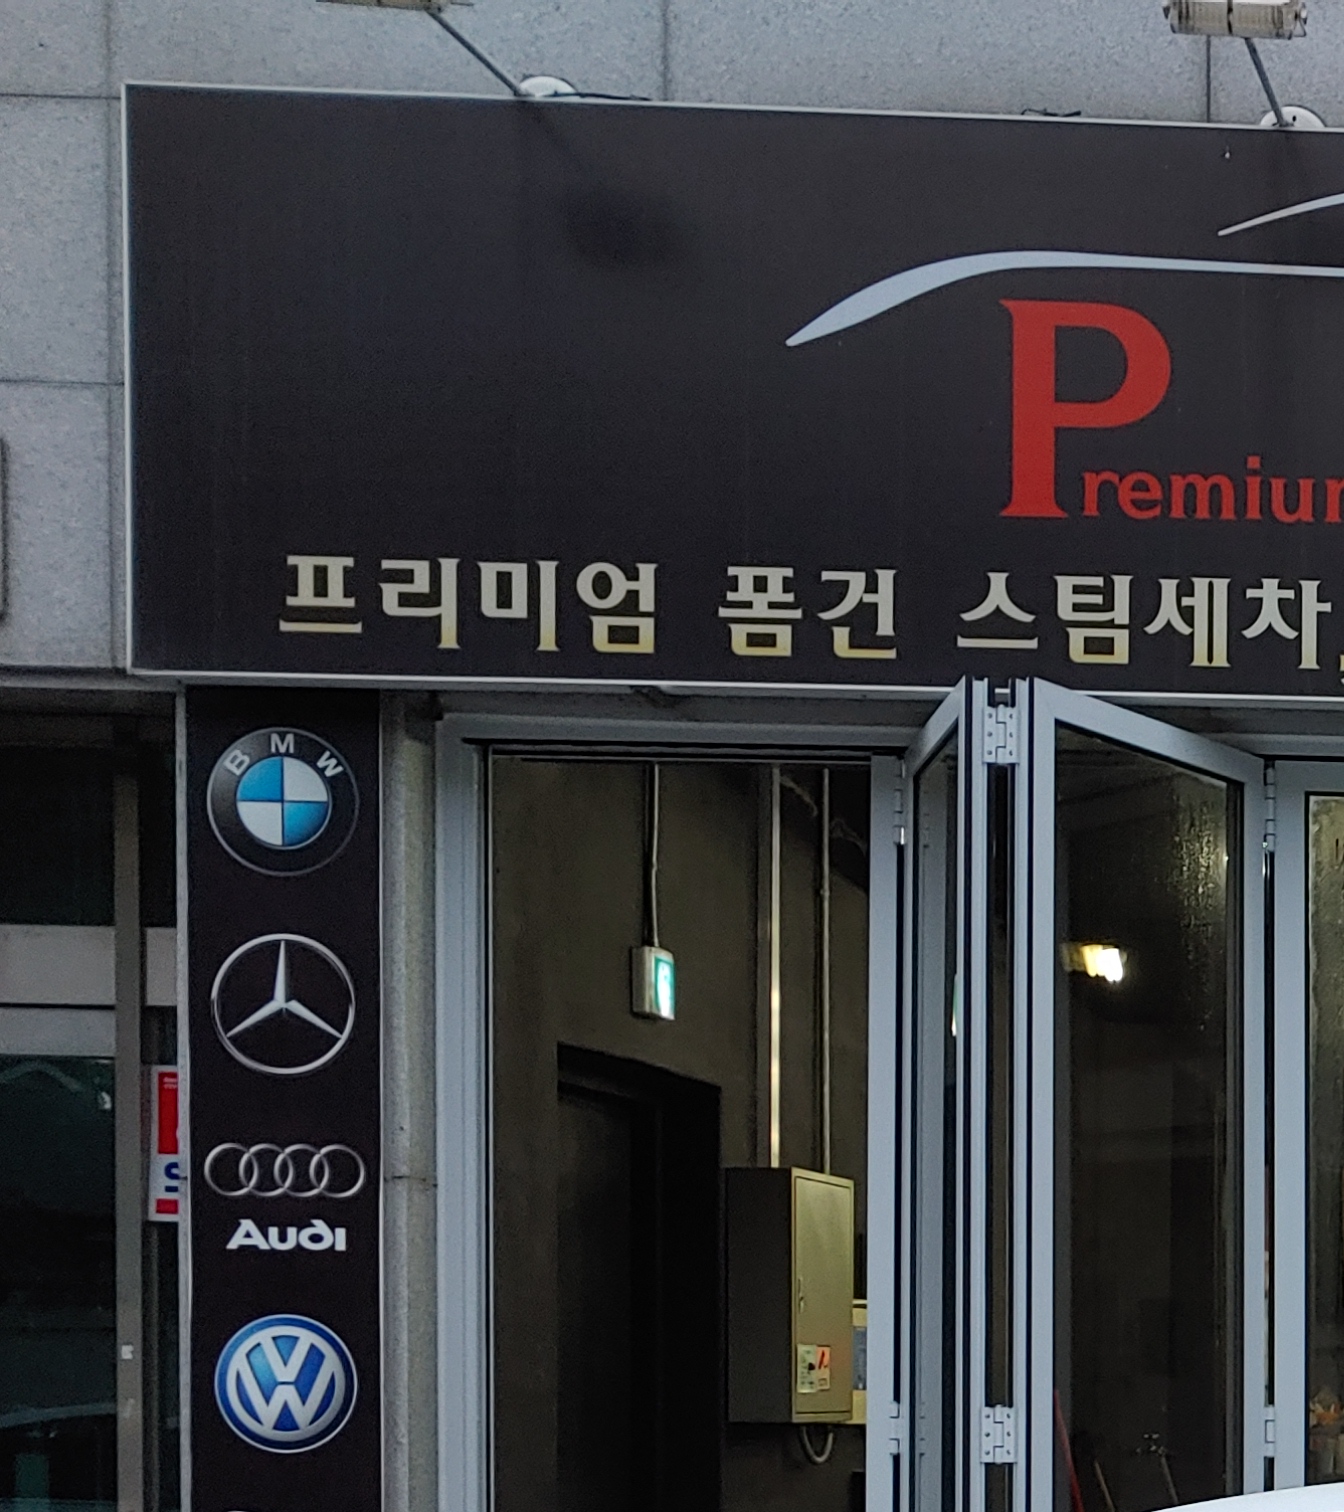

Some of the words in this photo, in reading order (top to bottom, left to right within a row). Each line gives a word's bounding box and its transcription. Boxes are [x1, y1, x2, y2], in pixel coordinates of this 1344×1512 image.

[279, 555, 658, 654] 프리미엄
[718, 566, 897, 659] 폼건
[222, 733, 344, 777] BMW
[226, 1218, 347, 1251] Audi
